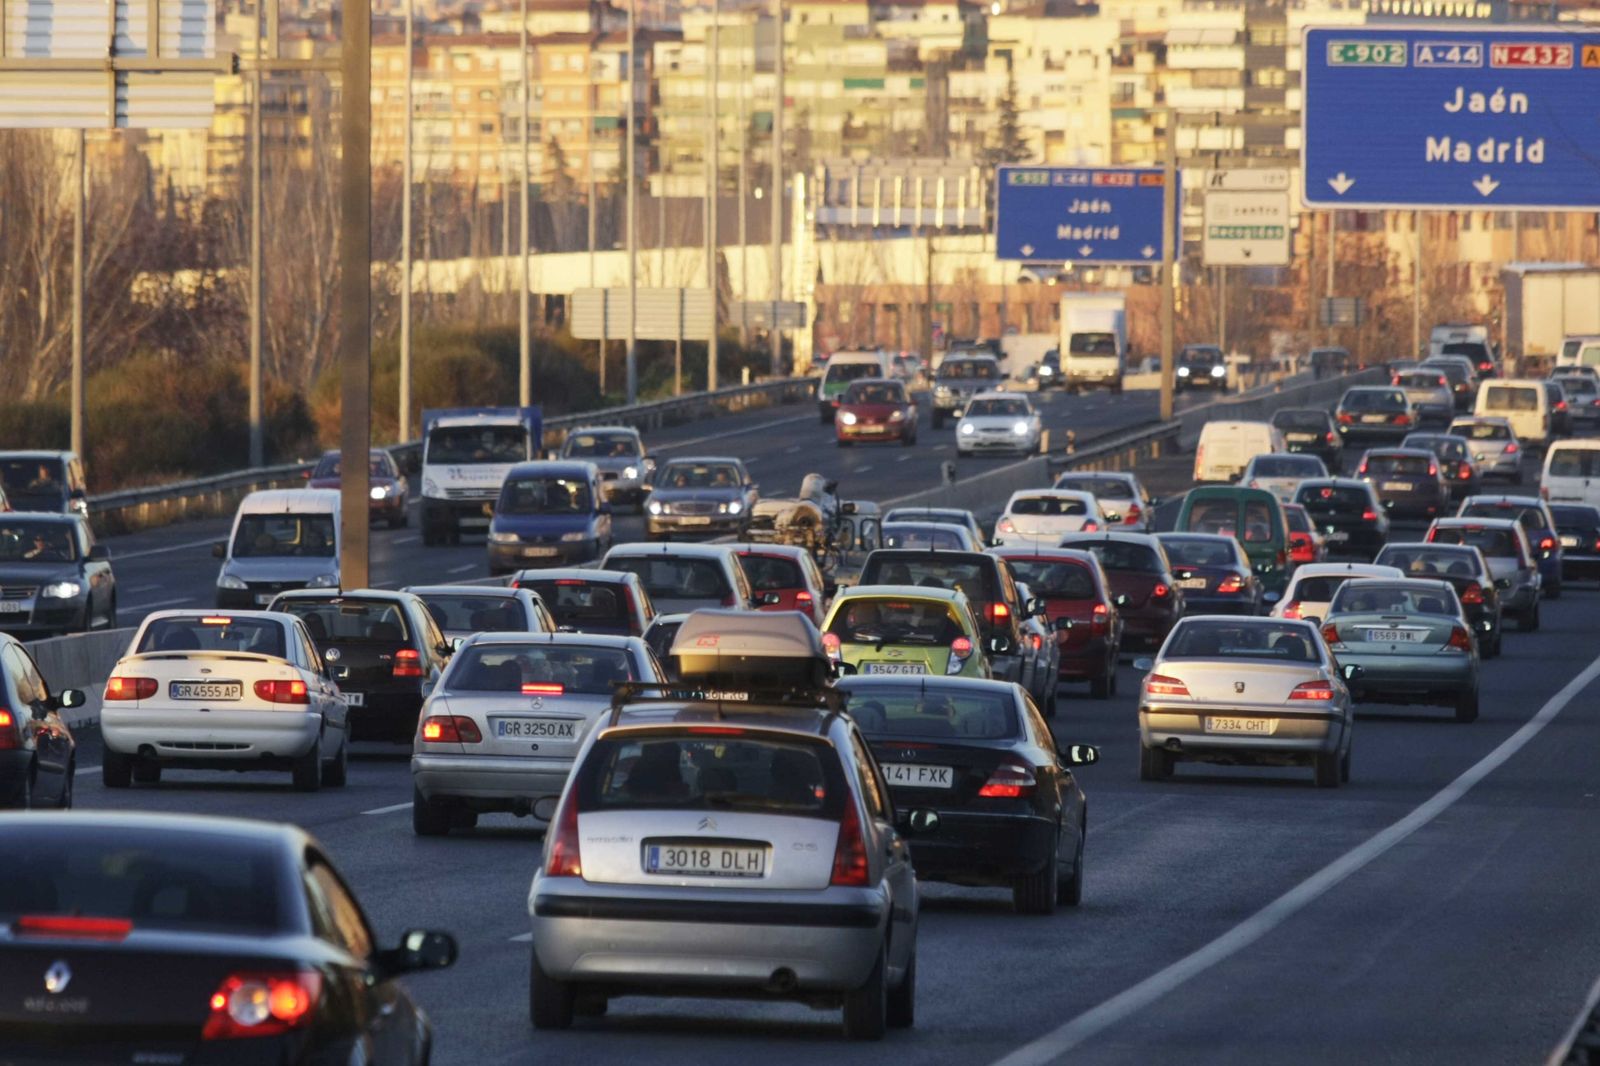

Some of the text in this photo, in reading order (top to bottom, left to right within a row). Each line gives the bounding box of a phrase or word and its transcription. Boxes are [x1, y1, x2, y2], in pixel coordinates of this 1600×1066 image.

[1331, 45, 1404, 64] E-902
[1418, 47, 1479, 64] A-44
[1494, 47, 1569, 66] N-432
[1444, 86, 1528, 114] Jaén
[1425, 136, 1545, 164] Madrid
[1067, 199, 1111, 214] Jaén
[1056, 224, 1120, 240] Madrid
[178, 685, 239, 698] GR 4555 AP
[505, 722, 574, 737] GR 3250 AX
[1215, 718, 1265, 731] 7334 CHT
[880, 766, 948, 784] 141 FXK
[665, 849, 759, 871] 3018 DLH
